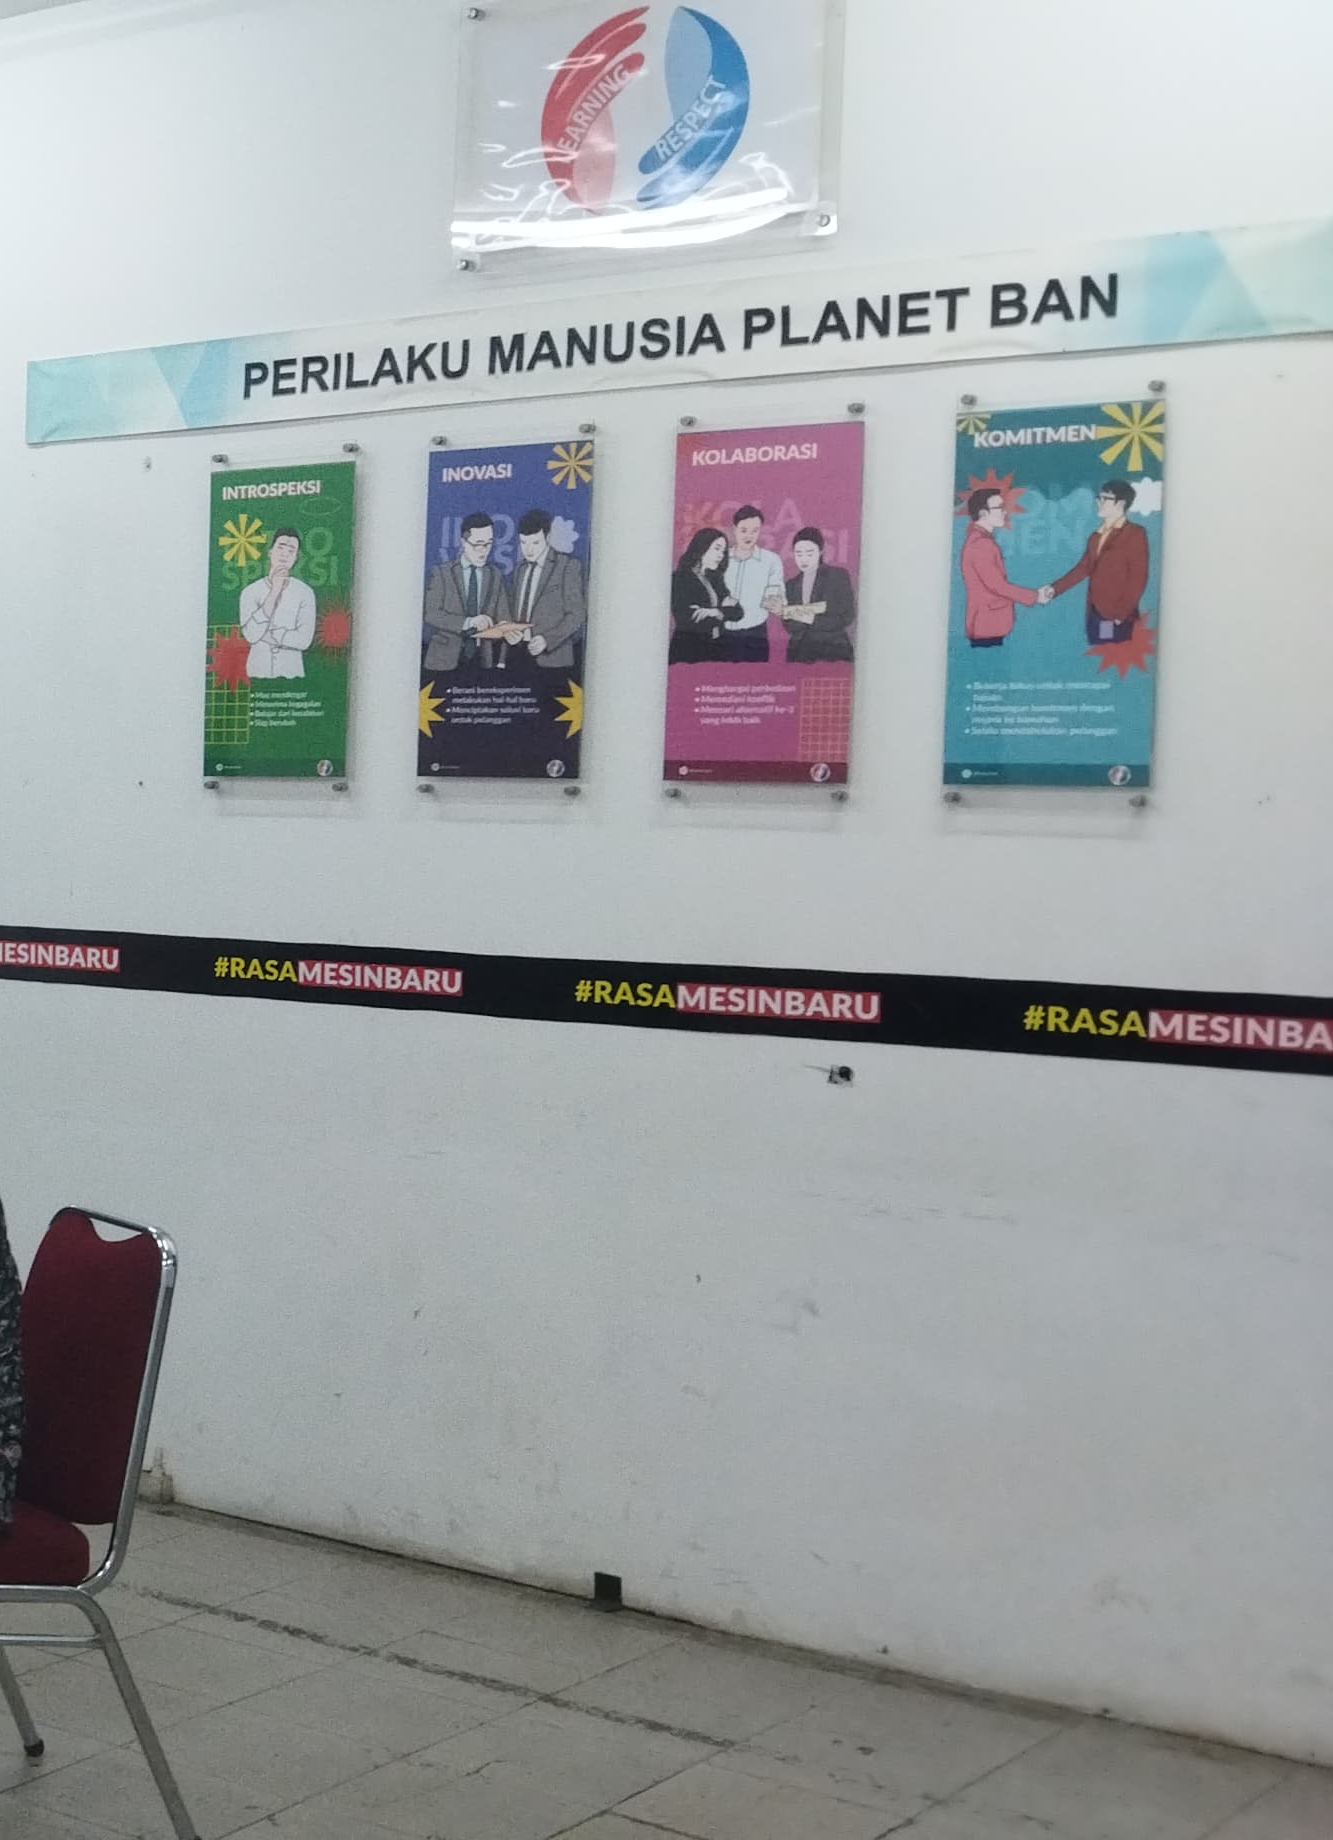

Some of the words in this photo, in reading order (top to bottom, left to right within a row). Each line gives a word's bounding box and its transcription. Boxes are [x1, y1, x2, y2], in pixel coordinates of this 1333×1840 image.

[655, 75, 726, 162] RESPECT
[243, 339, 470, 400] PERILAKU
[488, 313, 726, 376] MANUSIA
[743, 286, 971, 350] PLANET
[989, 272, 1118, 328] BAN
[974, 424, 1096, 448] KOMITMEN
[692, 442, 818, 467] KOLABORASI
[442, 463, 513, 483] INOVASI
[222, 479, 322, 501] INTROSPEKSI
[214, 955, 462, 995] #RASAMESINBARU
[574, 979, 880, 1020] #RASAMESINBARU
